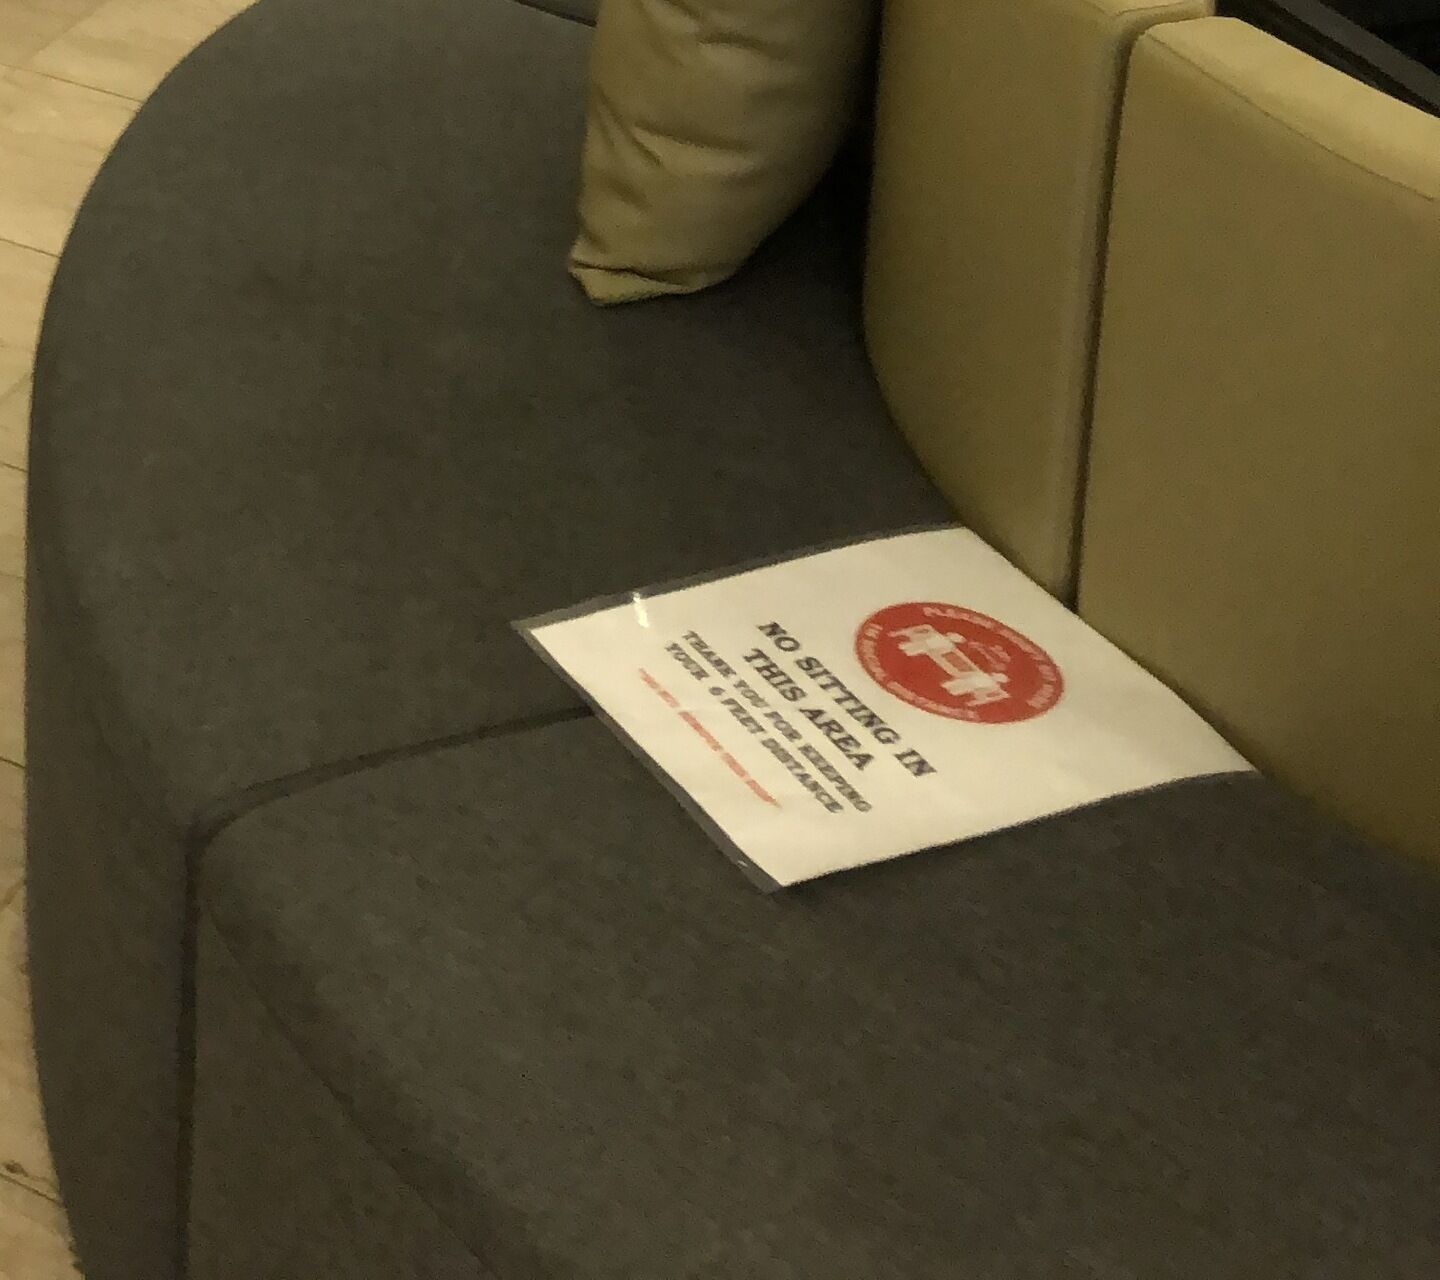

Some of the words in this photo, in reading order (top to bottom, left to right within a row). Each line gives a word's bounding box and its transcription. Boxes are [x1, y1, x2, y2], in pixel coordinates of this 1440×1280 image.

[664, 642, 710, 681] YOUR
[720, 697, 766, 734] FEET
[760, 737, 845, 814] DISTANCE
[682, 630, 737, 678] THANK
[732, 679, 770, 709] YOU
[763, 710, 803, 742] FOR
[796, 743, 873, 813] KEEPING
[742, 647, 808, 702] THIS
[797, 707, 876, 771] AREA
[755, 621, 802, 653] NO
[794, 656, 902, 745] SITTING
[893, 748, 939, 778] IN
